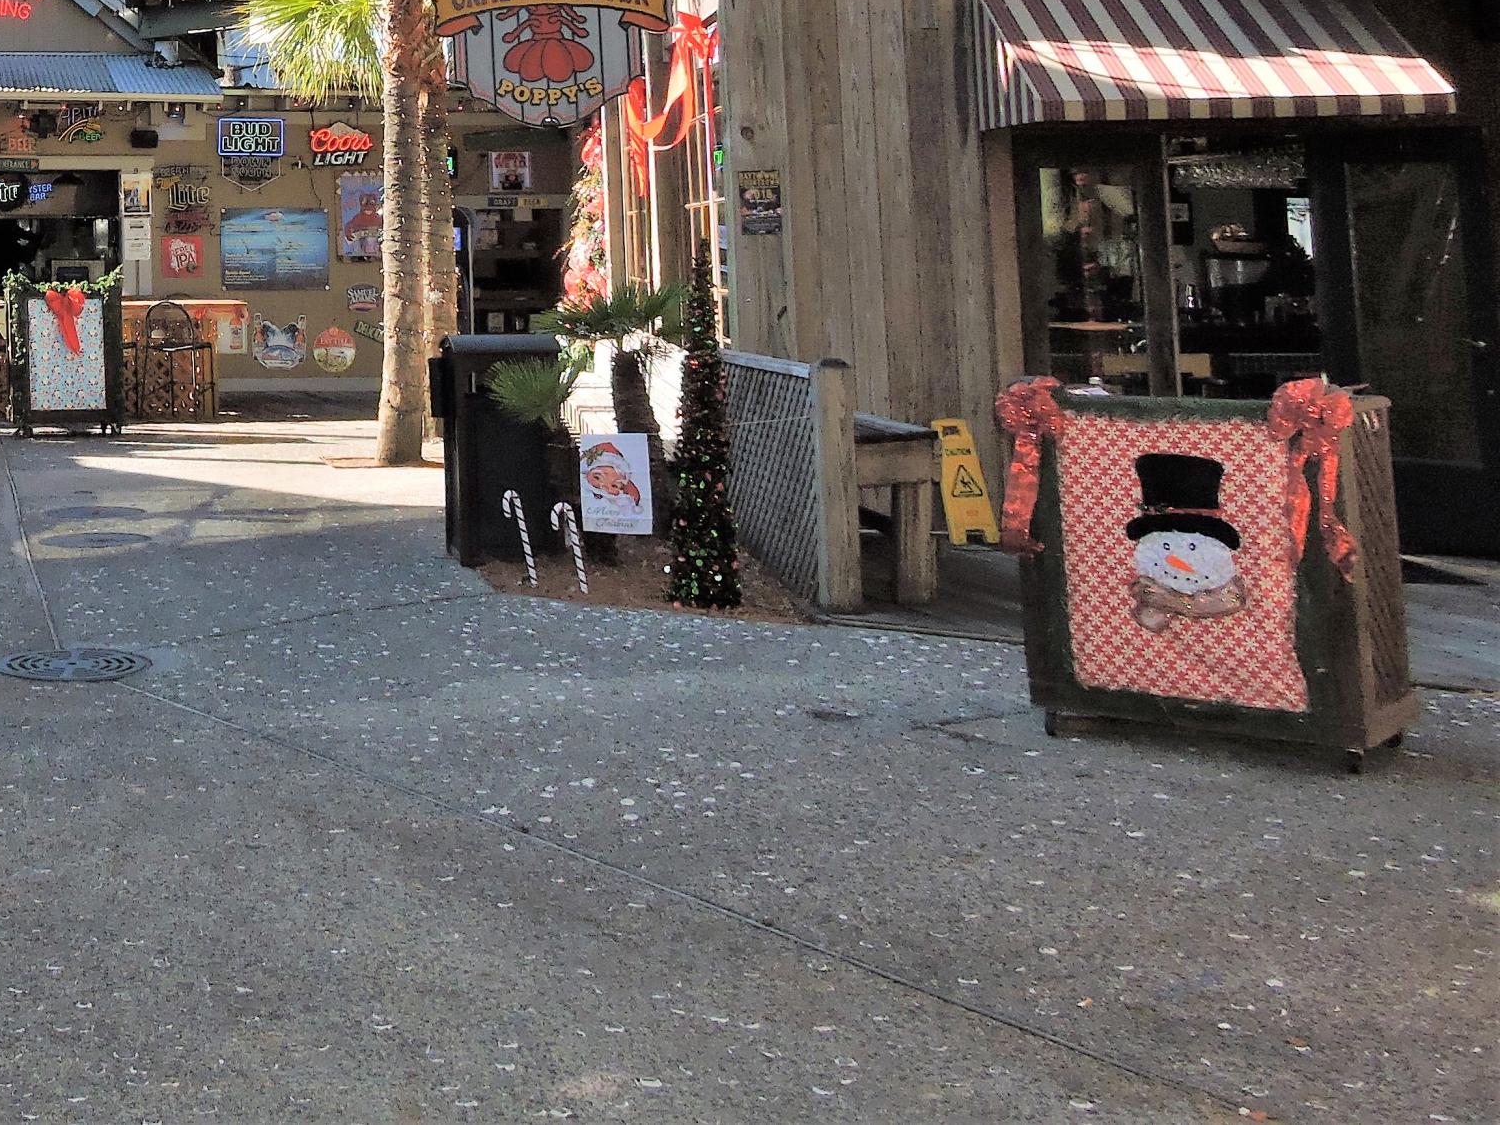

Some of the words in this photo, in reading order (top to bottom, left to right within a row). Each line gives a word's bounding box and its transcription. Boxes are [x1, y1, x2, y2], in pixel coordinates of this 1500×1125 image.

[497, 77, 604, 106] POPPY'S
[230, 122, 272, 137] BUD
[223, 137, 279, 152] LIGHT
[310, 128, 373, 153] Coors
[314, 152, 368, 166] LIGHT
[29, 183, 52, 193] YSTER
